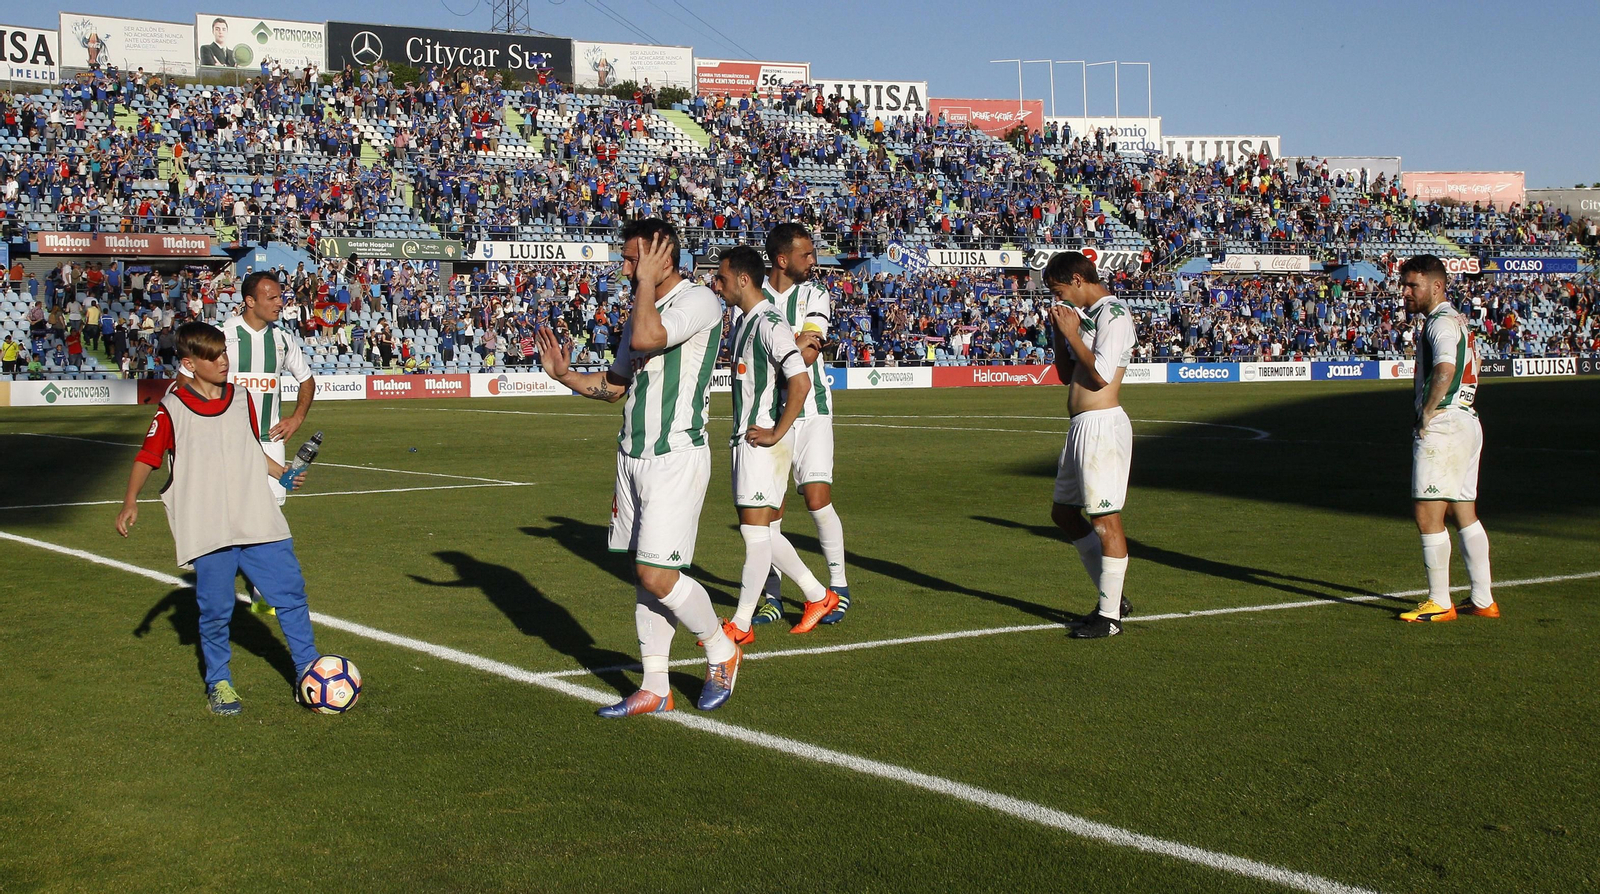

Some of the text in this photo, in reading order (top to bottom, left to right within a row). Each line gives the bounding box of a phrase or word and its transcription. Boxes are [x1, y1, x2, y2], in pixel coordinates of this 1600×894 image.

[273, 28, 323, 44] TECNOCASA
[406, 36, 500, 71] Citycar
[45, 235, 91, 247] Mahou
[104, 235, 149, 248] Mahou
[162, 236, 206, 249] Mahou
[509, 244, 566, 260] LUJISA
[940, 251, 987, 265] LUJISA
[1504, 260, 1576, 272] OCASO SEGUROS
[1178, 366, 1229, 379] Gedesco
[1258, 366, 1294, 378] TIBERMOTOR
[1295, 366, 1306, 377] SUR
[1493, 364, 1506, 372] Sur
[1527, 359, 1576, 375] LUJISA
[234, 375, 277, 392] tango
[425, 378, 462, 390] Mahou
[881, 372, 914, 383] TECNOCASA
[316, 381, 362, 394] y Ricardo
[373, 378, 411, 391] Mahou
[62, 386, 110, 398] TECNOCASA
